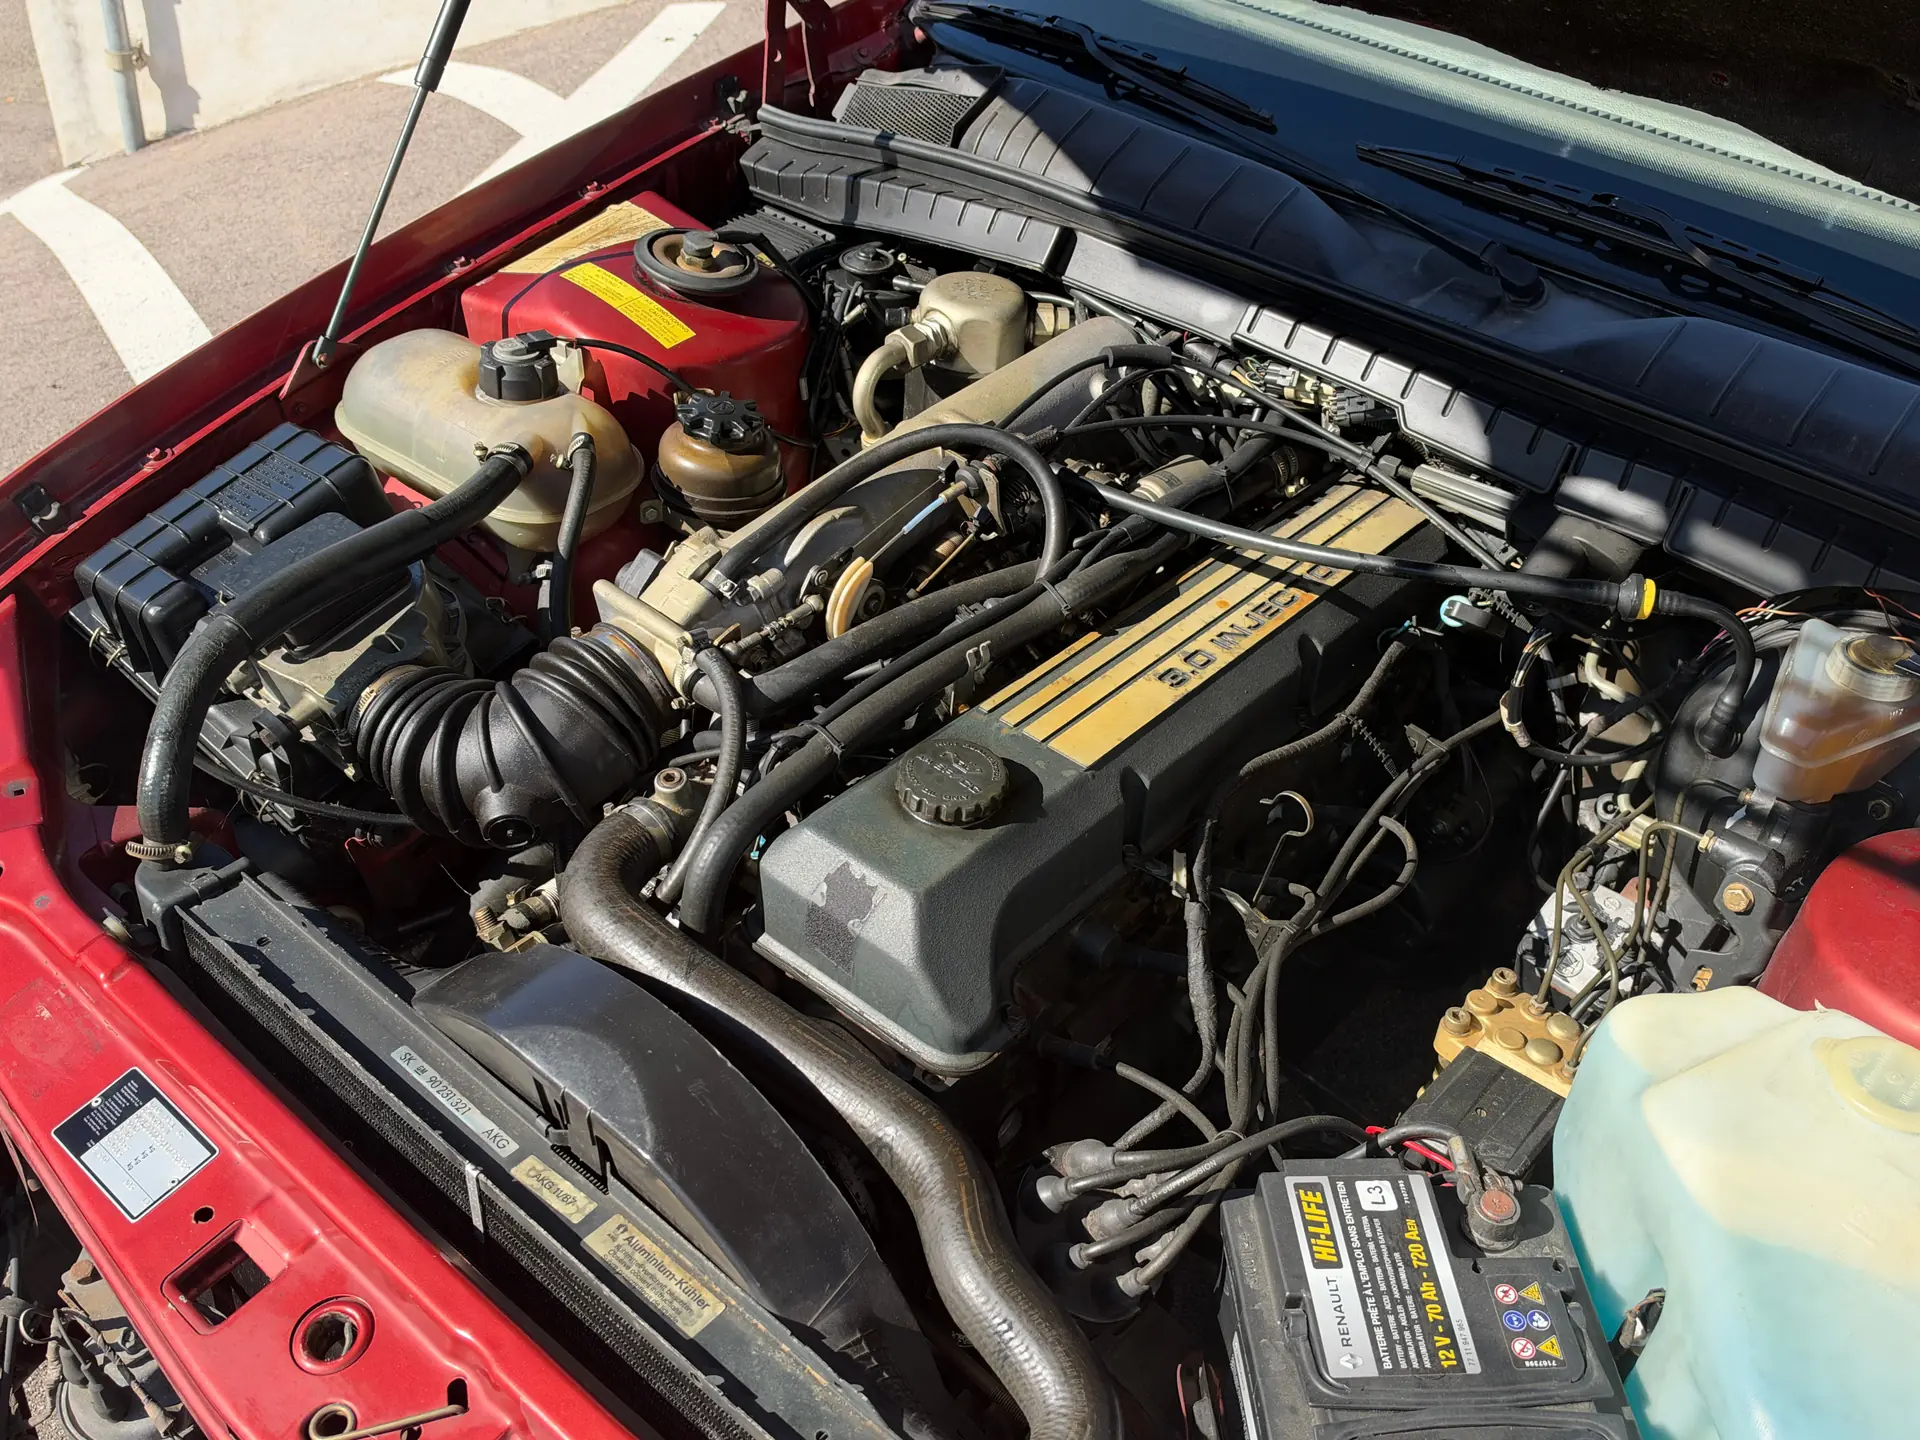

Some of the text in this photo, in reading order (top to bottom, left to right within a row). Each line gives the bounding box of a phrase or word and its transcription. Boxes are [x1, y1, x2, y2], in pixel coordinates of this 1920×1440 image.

[647, 307, 671, 325] CAUTION
[1154, 646, 1217, 688] 3.0
[398, 1049, 417, 1066] SK
[480, 1126, 511, 1151] AKG
[530, 1171, 555, 1191] AKG
[1365, 1184, 1387, 1205] L3
[1372, 1217, 1386, 1244] БАТАРЕЯ
[1407, 1242, 1429, 1268] 720
[621, 1232, 712, 1311] Aluminium-Kühler
[1334, 1180, 1393, 1369] BATTERIE PRÊTE À L'EMPLOI SANS ENTRETIEN
[1373, 1266, 1387, 1291] BATTERIA
[1381, 1294, 1392, 1310] ACCU
[1417, 1280, 1439, 1301] Ah
[1324, 1275, 1353, 1348] RENAULT
[1395, 1304, 1408, 1326] AKÜLER
[1404, 1294, 1418, 1319] BATERIE
[1424, 1303, 1445, 1322] 70
[1386, 1313, 1400, 1340] BATTERIE
[1402, 1329, 1420, 1368] AKUMULATOR
[1412, 1323, 1432, 1368] AKKUMULÁTOR
[1432, 1334, 1452, 1347] V
[1394, 1343, 1408, 1369] BATTERY
[1436, 1348, 1458, 1368] 12
[1466, 1357, 1476, 1366] 77
